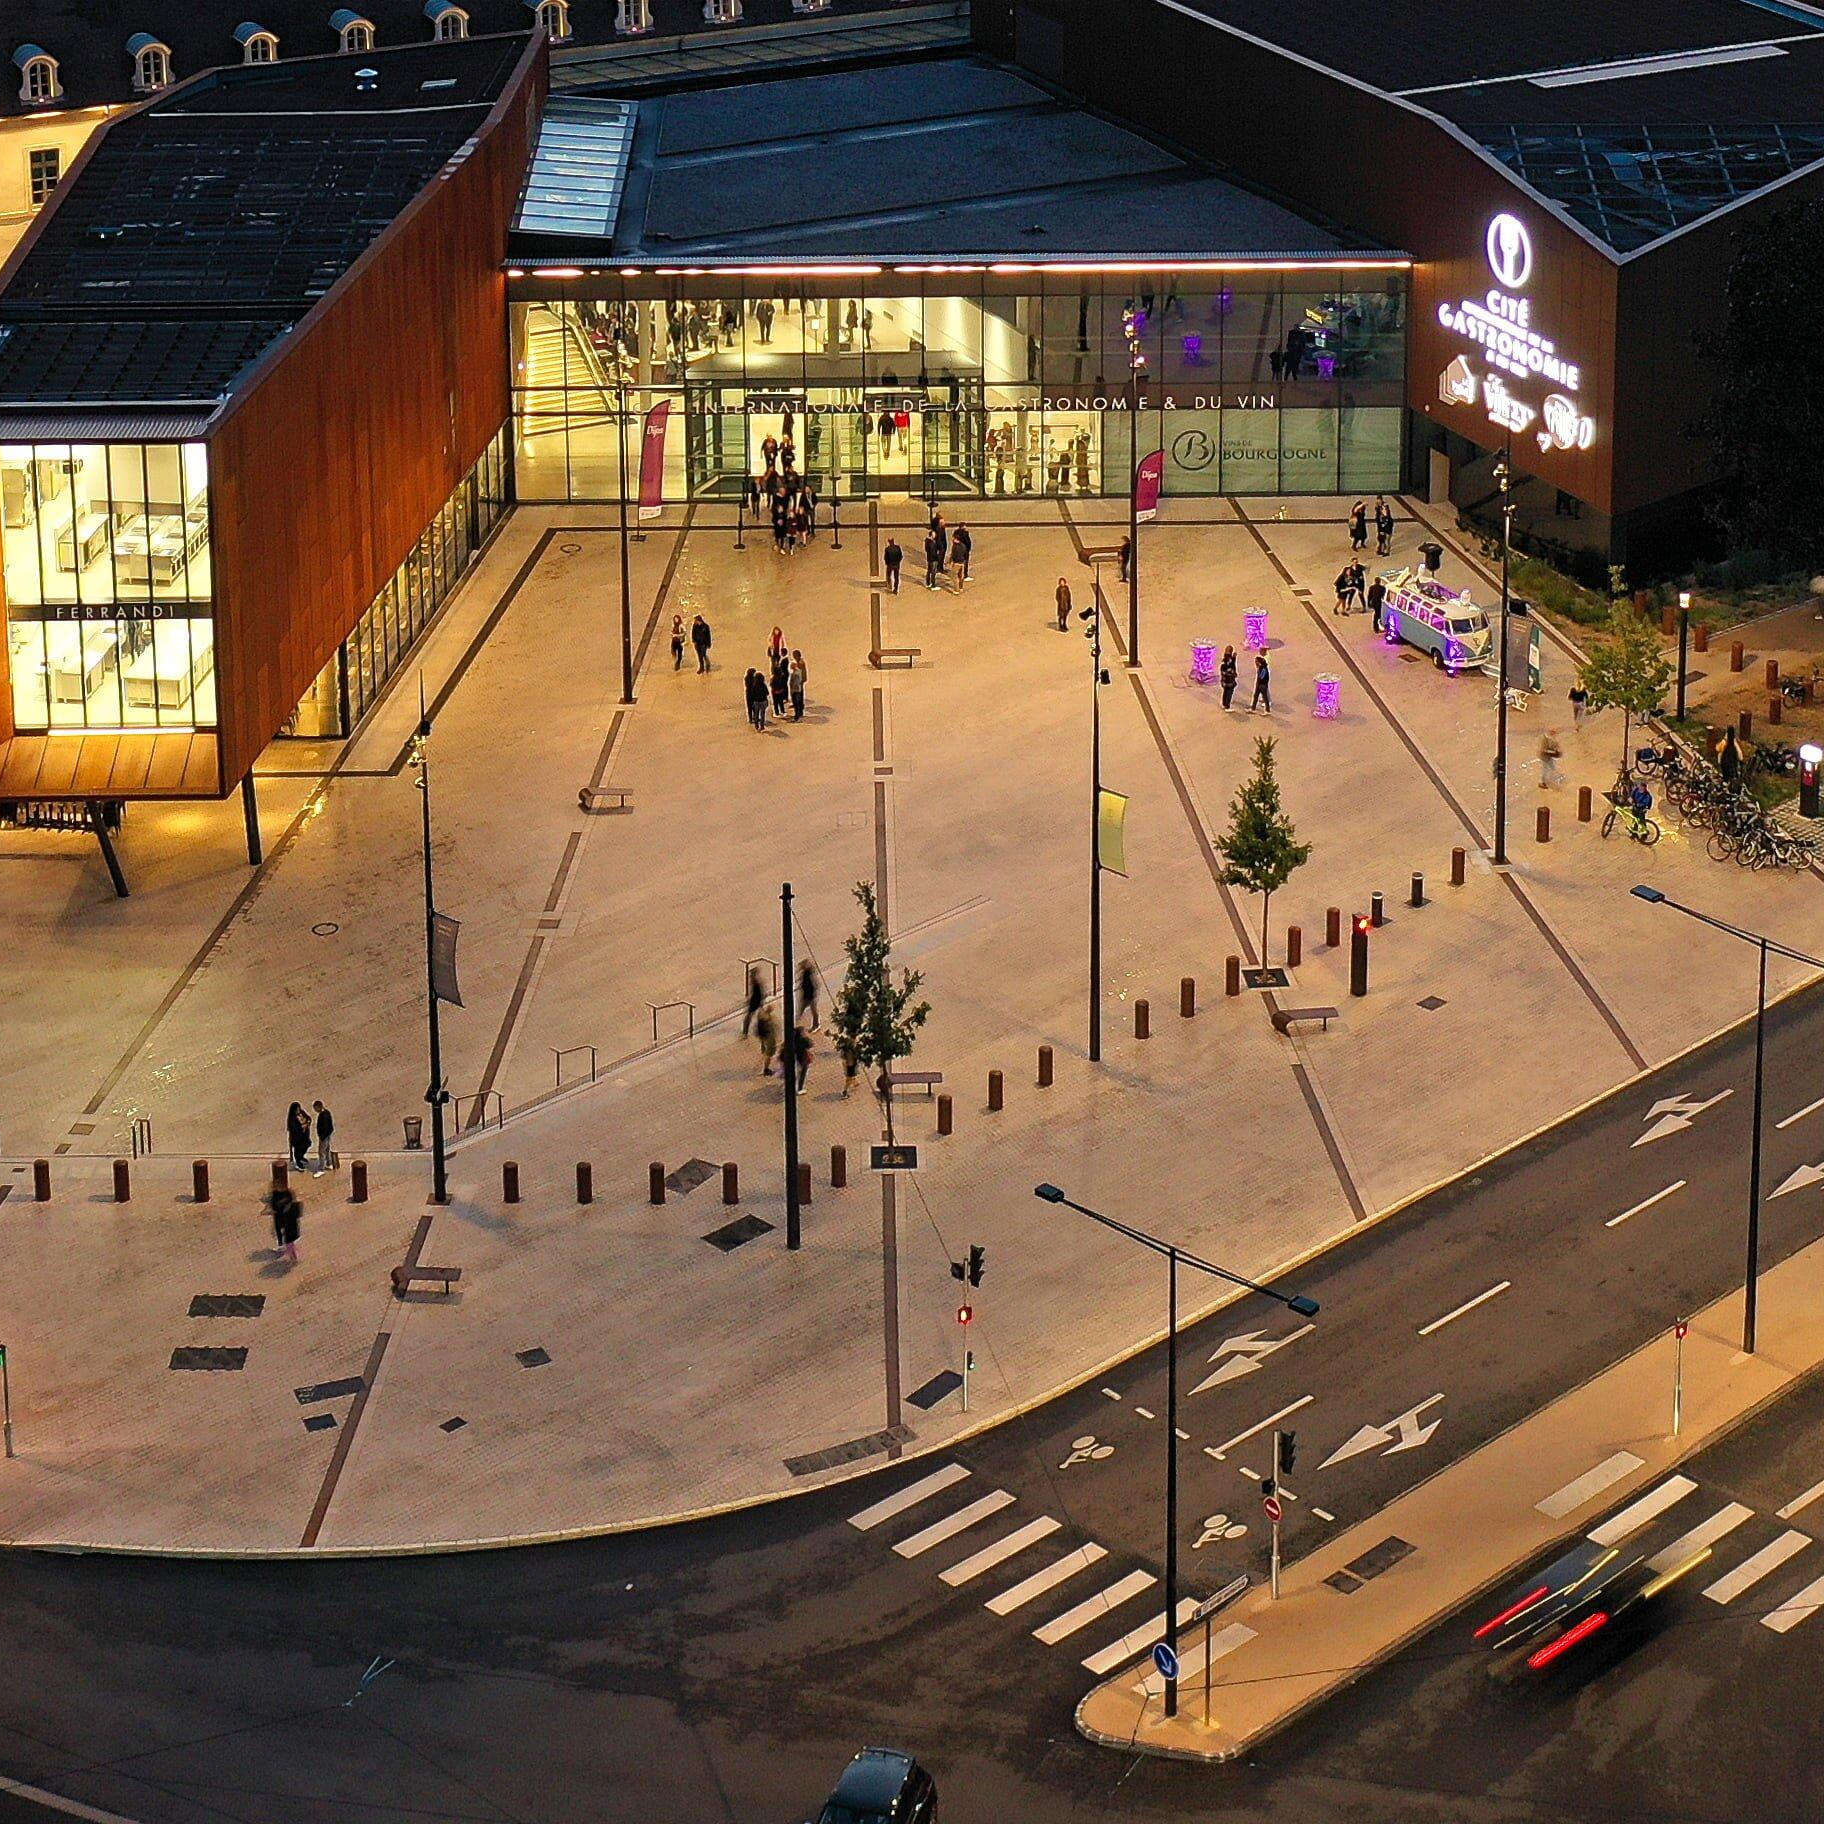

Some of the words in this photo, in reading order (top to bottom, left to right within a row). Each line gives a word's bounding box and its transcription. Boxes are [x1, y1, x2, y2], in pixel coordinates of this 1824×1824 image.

[1486, 289, 1530, 328] CITÉ
[1438, 303, 1579, 391] GASTRONOMIE
[903, 399, 927, 413] DE
[1164, 397, 1177, 410] &
[1195, 396, 1221, 409] DU
[1238, 395, 1275, 409] VIN
[1222, 448, 1327, 461] BOURGOGNE
[56, 605, 174, 619] FERRANDI
